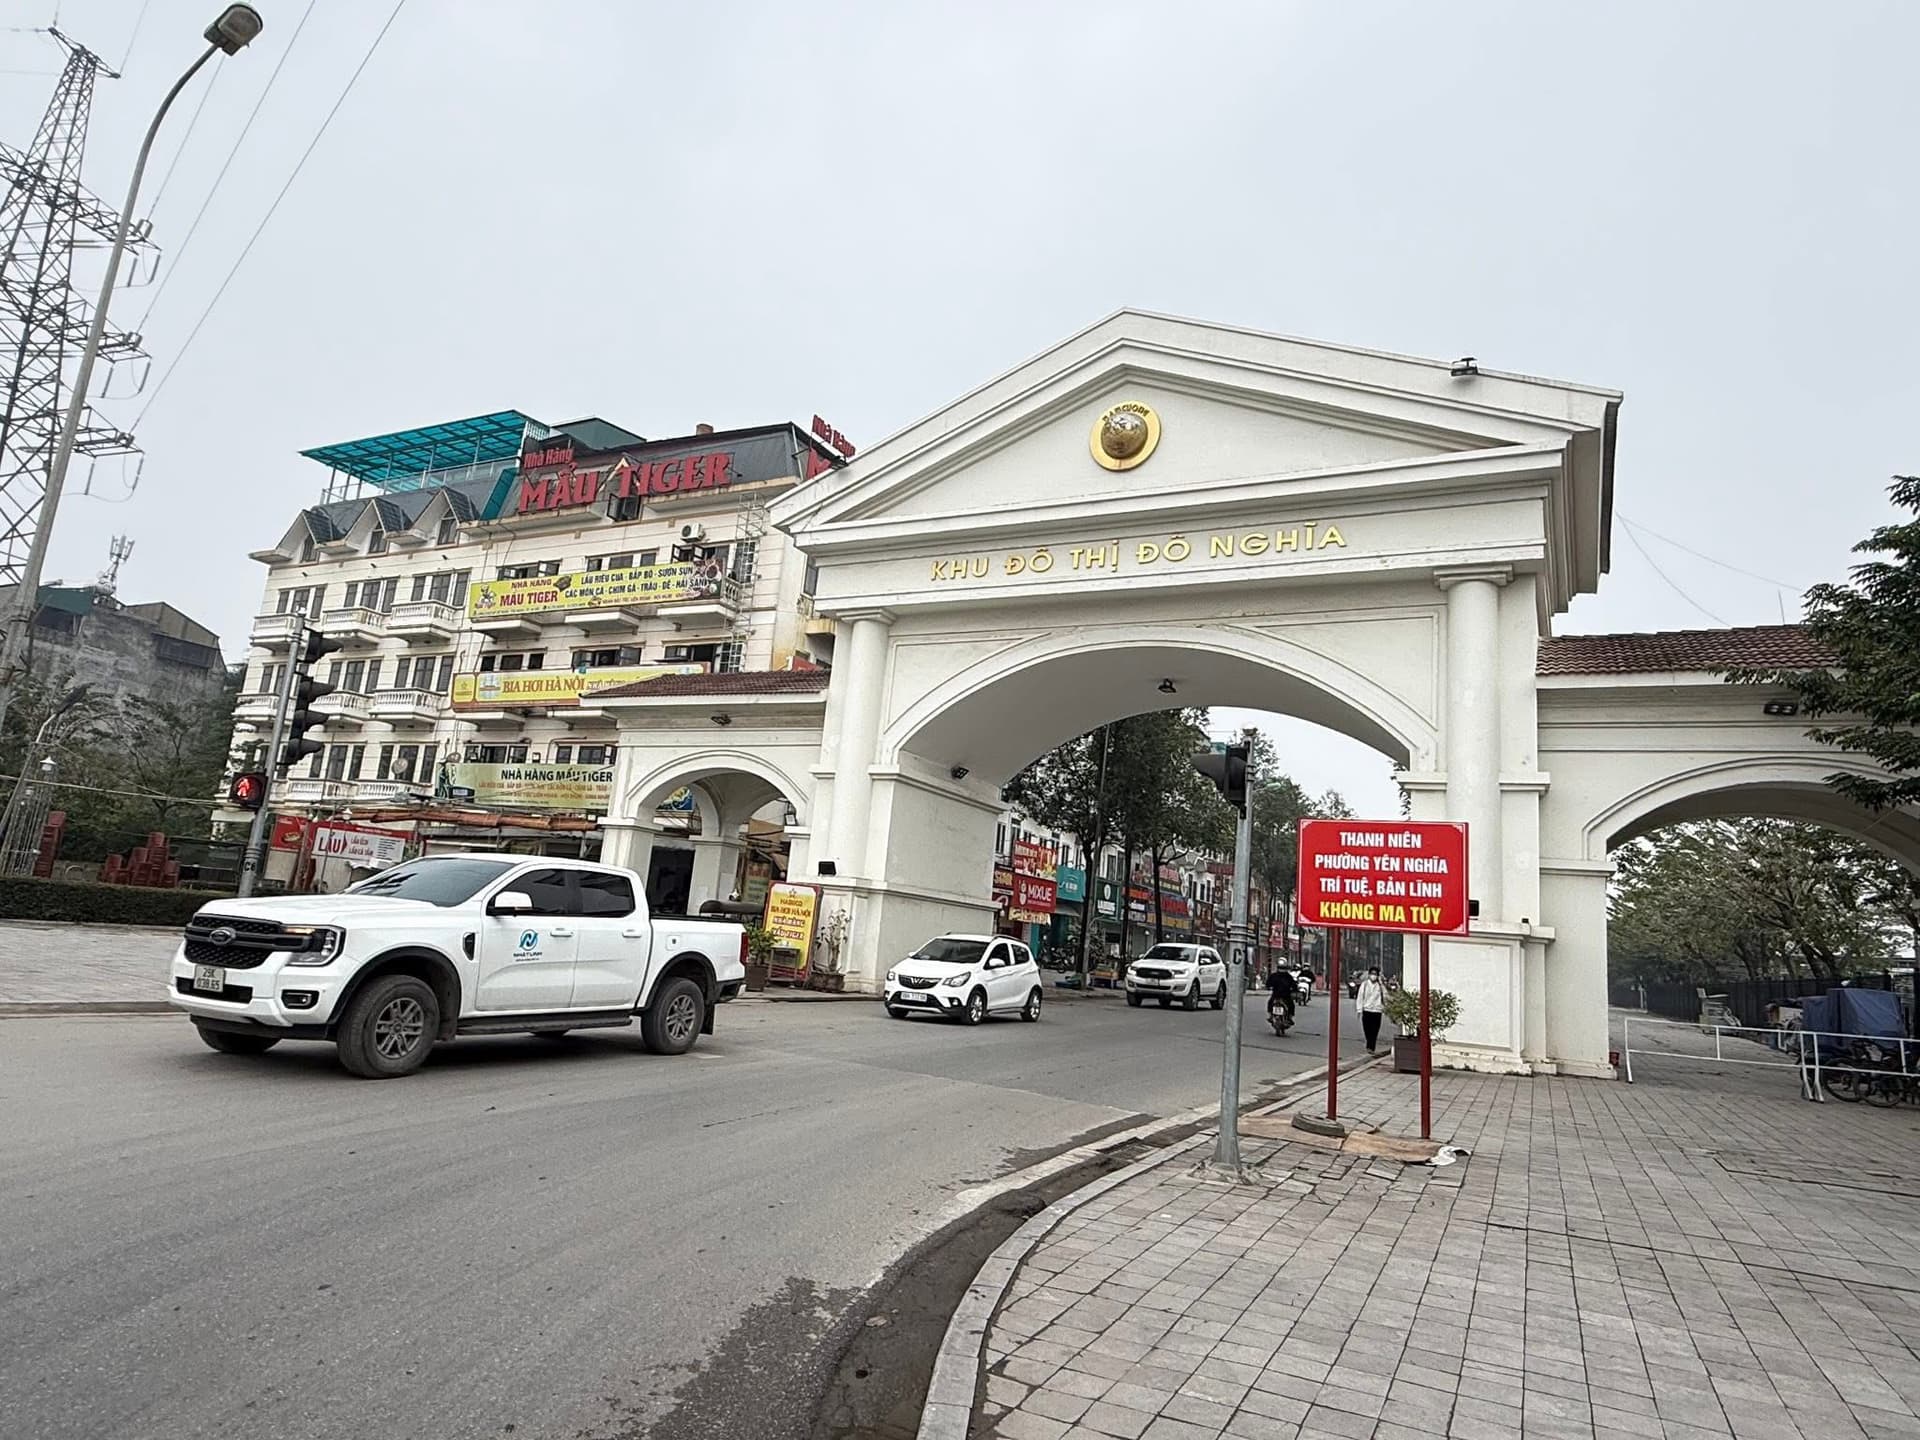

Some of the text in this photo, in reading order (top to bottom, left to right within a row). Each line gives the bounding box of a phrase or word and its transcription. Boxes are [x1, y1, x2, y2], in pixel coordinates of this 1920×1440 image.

[524, 448, 574, 468] Nhà Hàng
[617, 451, 731, 498] TIGER
[931, 521, 1347, 581] KHU ĐÔ THỊ ĐÔ NGHĨA
[527, 590, 558, 604] TIGER
[503, 680, 520, 693] BIA
[522, 679, 543, 692] HƠI
[545, 676, 562, 691] HÀ
[564, 675, 585, 694] NỘI
[501, 767, 522, 780] NHÀ
[524, 768, 554, 781] HÀNG
[581, 770, 613, 782] TIGER
[1339, 831, 1422, 849] THANH NIÊN
[1315, 851, 1449, 874] PHƯỜNG YÊN NGHĨA
[1028, 884, 1053, 901] MIXUE
[1319, 875, 1443, 898] TRÍ TUỆ, BẢN LĨNH
[1319, 899, 1442, 925] KHÔNG MA TÚY
